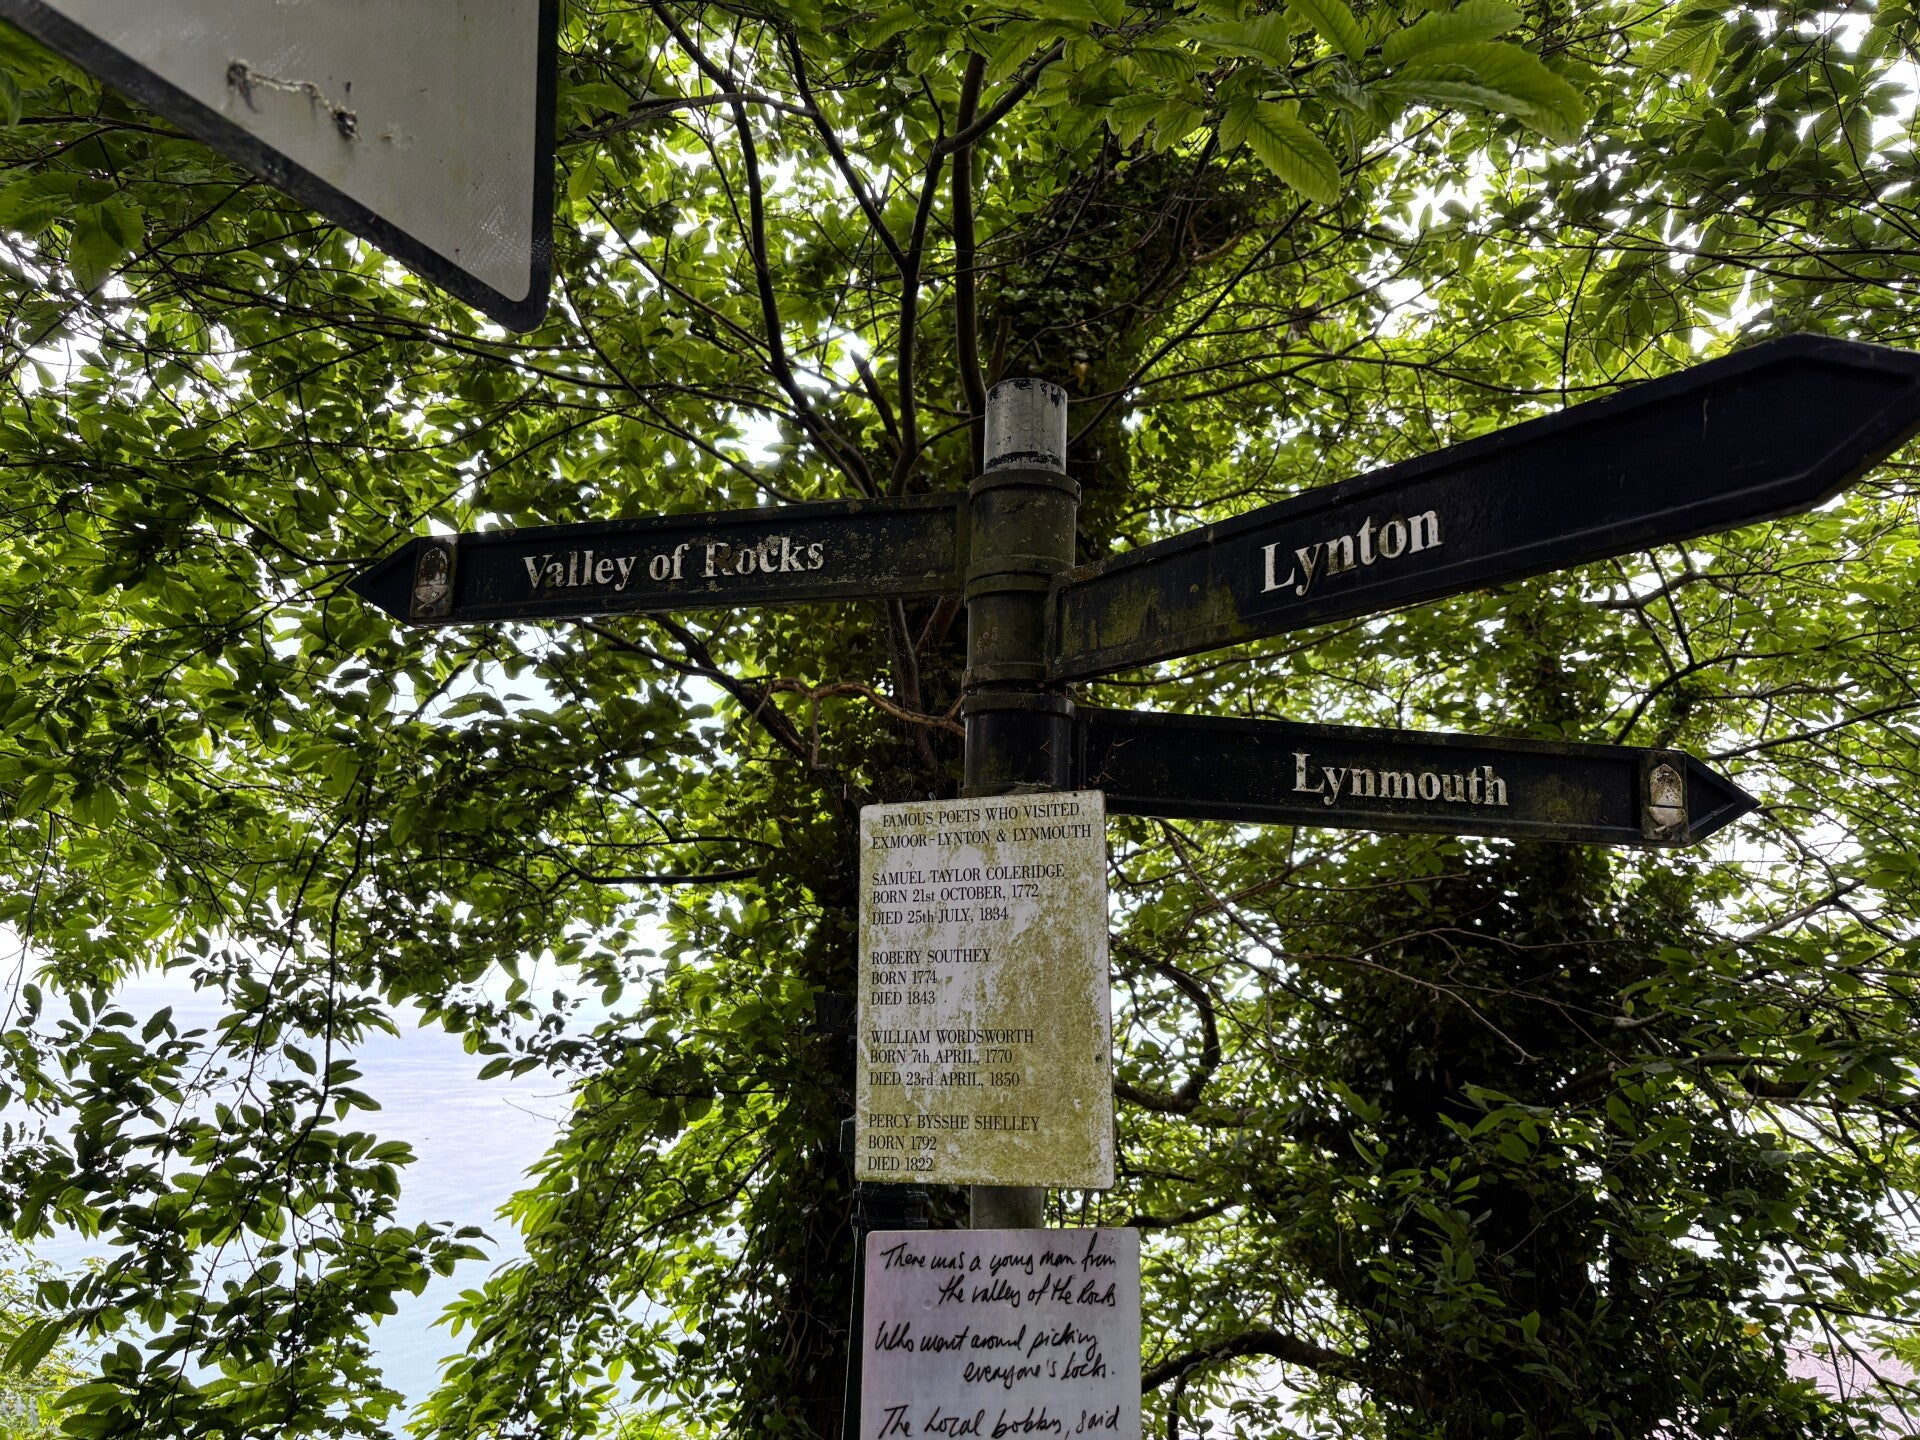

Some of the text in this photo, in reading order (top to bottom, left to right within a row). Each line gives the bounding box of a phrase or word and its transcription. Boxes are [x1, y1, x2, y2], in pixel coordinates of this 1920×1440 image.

[1260, 509, 1444, 597] Lynton
[523, 535, 824, 591] Valley of Rocks
[1291, 752, 1509, 807] Lynmouth
[883, 803, 1079, 827] FAMOUS POETS WHO VISITED
[997, 831, 1006, 842] &
[1013, 824, 1091, 840] LYNMOUTH
[872, 864, 1065, 886] SAMUEL TAYLOR COLERIDGE
[872, 884, 1038, 904] BORN 21st OCTOBER, 1772
[872, 907, 1008, 925] DIED 25th JULY, 1834
[872, 949, 991, 965] ROBERY SOUTHEY
[872, 971, 937, 985] BORN 1774
[871, 991, 935, 1005] DIED 1843
[872, 1029, 1034, 1044] WILLIAM WORDSWORTH
[870, 1050, 906, 1064] BORN
[912, 1050, 930, 1063] 7th
[985, 1050, 1012, 1063] 1770
[870, 1073, 901, 1085] DIED
[906, 1072, 934, 1086] 23rd
[990, 1073, 1020, 1086] 1850
[869, 1115, 1040, 1131] PERCY BYSSHE SHELLEY
[869, 1136, 937, 1150] BORN 1792
[868, 1157, 933, 1172] DIED 1822
[880, 1242, 925, 1270] There
[931, 1251, 964, 1270] was
[970, 1258, 981, 1271] a
[990, 1255, 1033, 1276] young
[1040, 1252, 1076, 1266] man
[939, 1273, 1116, 1308] the valley of the Rocks
[875, 1320, 1098, 1361] Who went around picking
[879, 1405, 913, 1440] The
[1076, 1405, 1120, 1434] said
